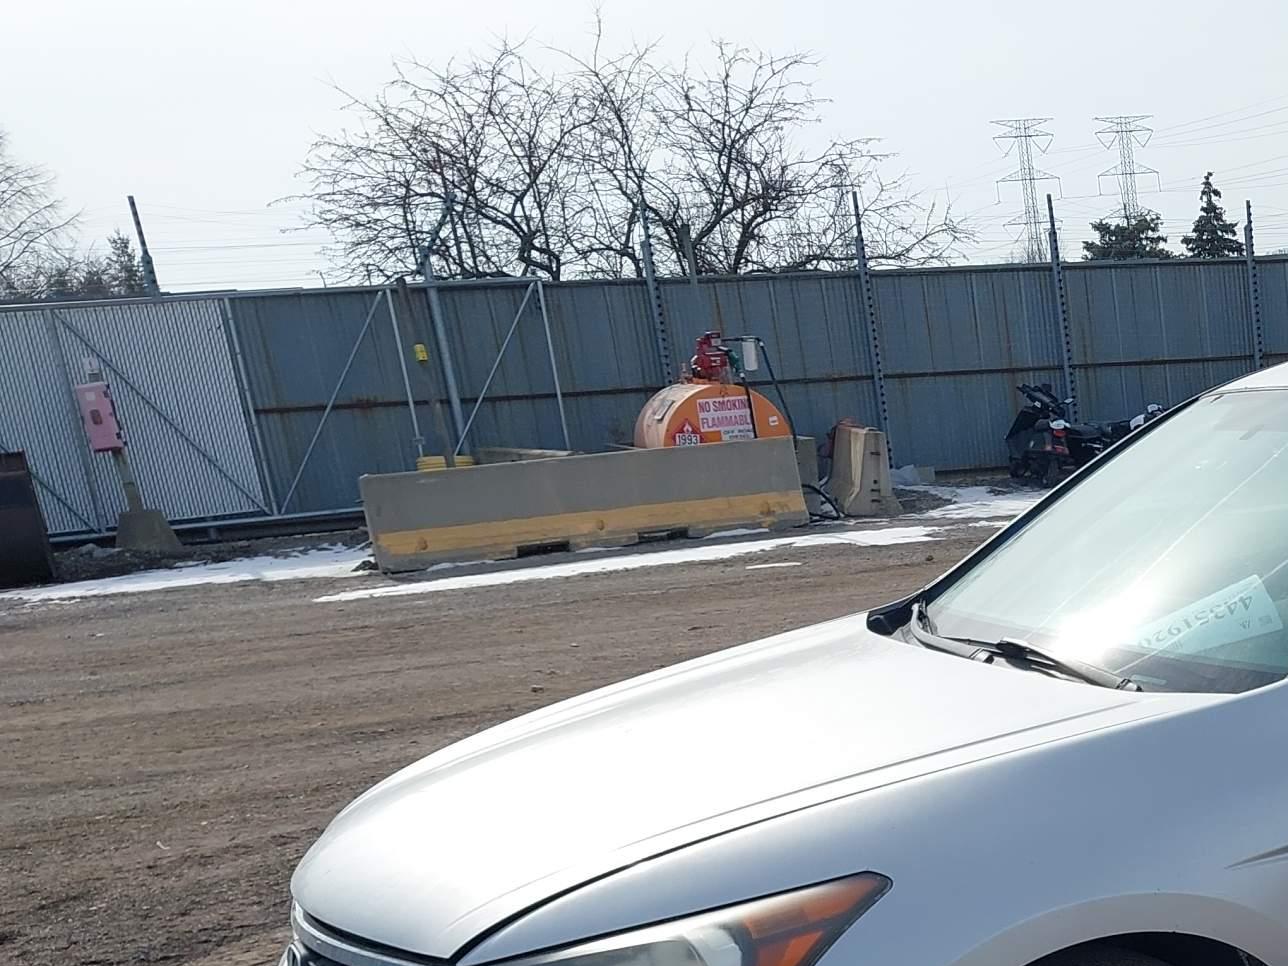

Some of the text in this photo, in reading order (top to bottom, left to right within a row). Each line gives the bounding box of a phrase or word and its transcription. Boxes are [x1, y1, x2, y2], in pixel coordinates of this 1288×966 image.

[699, 400, 711, 414] NO
[677, 434, 699, 446] 1993
[1138, 595, 1253, 648] 44351920
